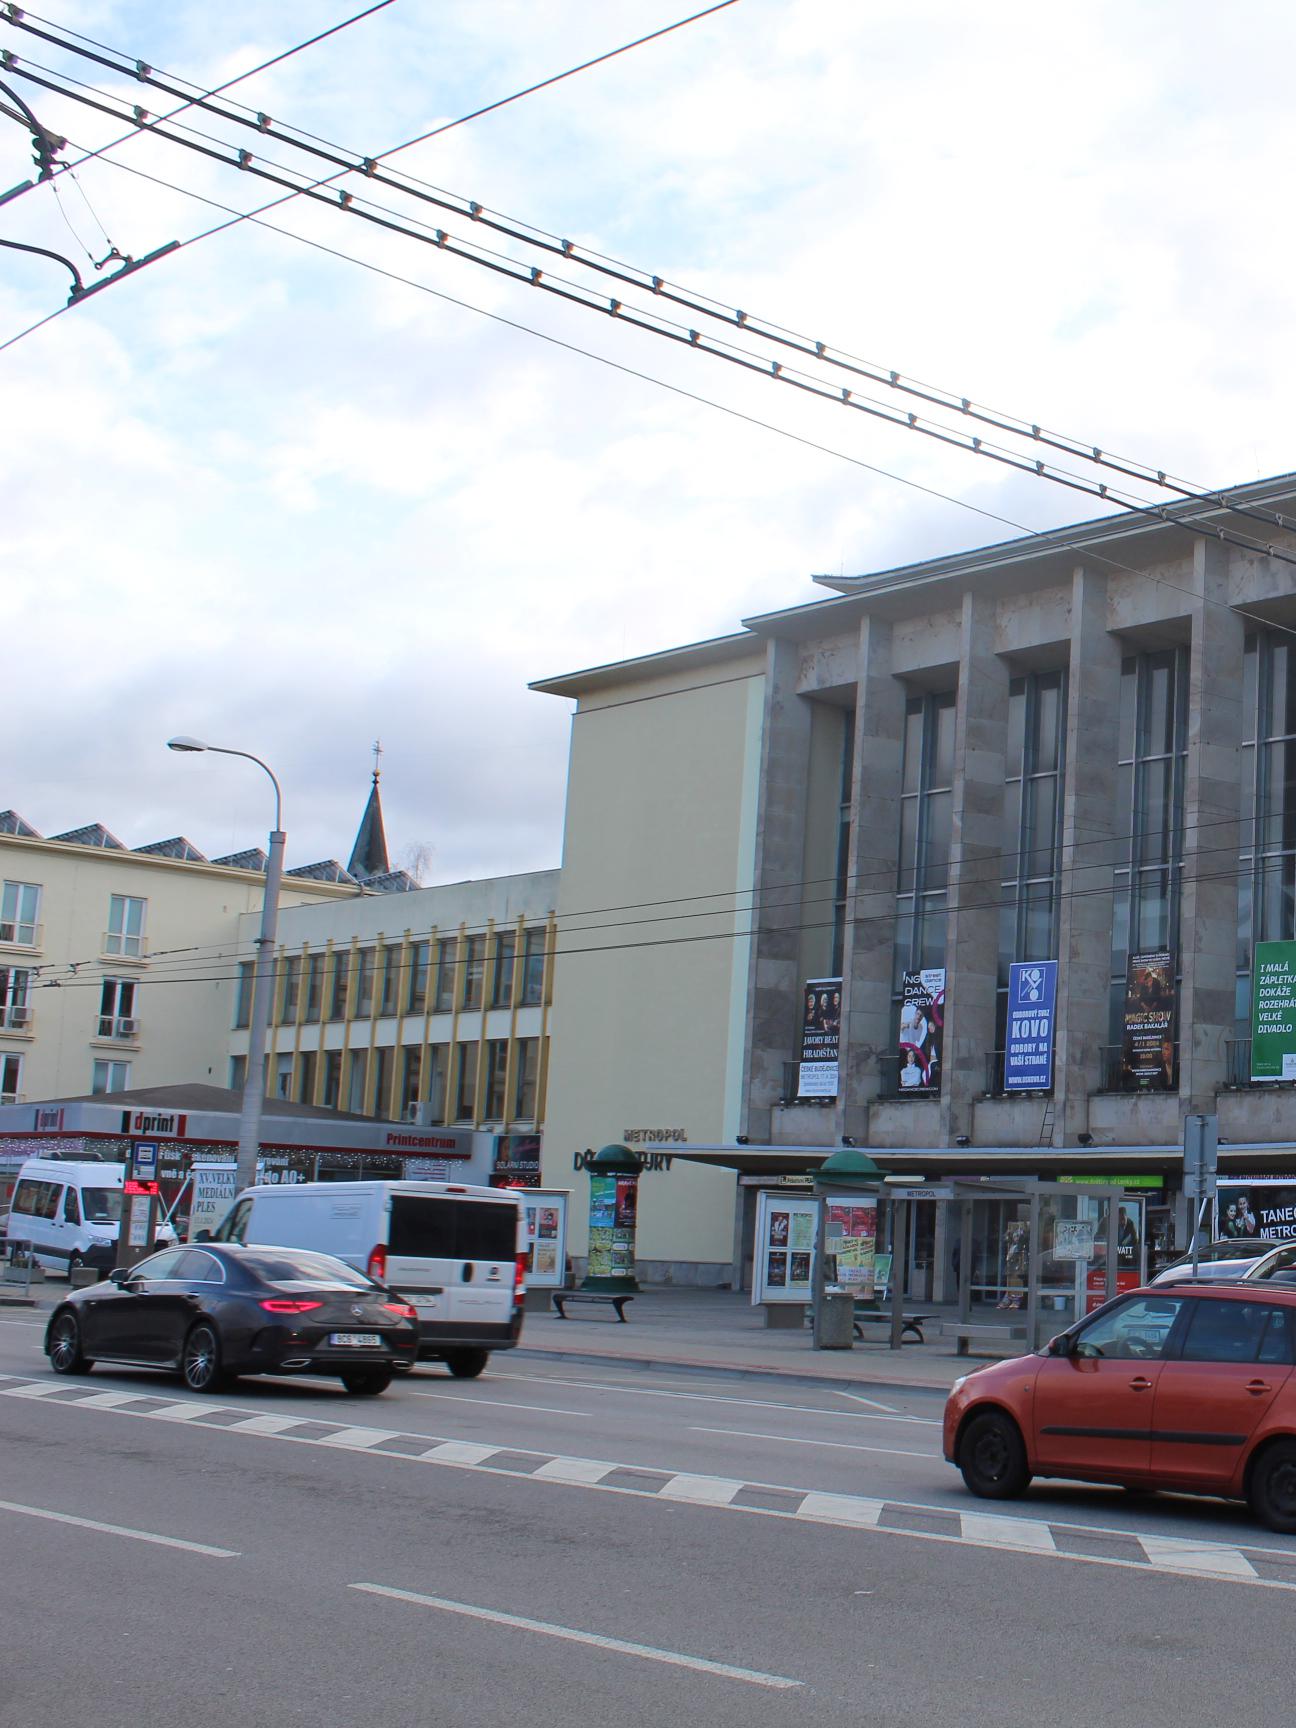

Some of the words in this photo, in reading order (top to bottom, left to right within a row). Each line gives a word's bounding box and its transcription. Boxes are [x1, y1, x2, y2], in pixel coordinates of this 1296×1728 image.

[1266, 961, 1289, 972] MALÁ
[905, 985, 941, 996] DANCE
[1259, 985, 1291, 997] DOKÁŽE
[904, 997, 934, 1007] CREW
[1258, 1010, 1282, 1021] VELKÉ
[1012, 1019, 1049, 1038] KOVO
[1258, 1023, 1293, 1034] DIVADLO
[824, 1035, 839, 1044] BEAT
[1010, 1043, 1036, 1053] ODBORY
[1038, 1043, 1048, 1052] NA
[135, 1111, 175, 1134] dprint
[387, 1133, 457, 1149] Printcentrum
[624, 1128, 688, 1143] METROPOL
[519, 1161, 539, 1169] STUDIO
[907, 1190, 936, 1198] METROPOL
[196, 1200, 217, 1213] PLES
